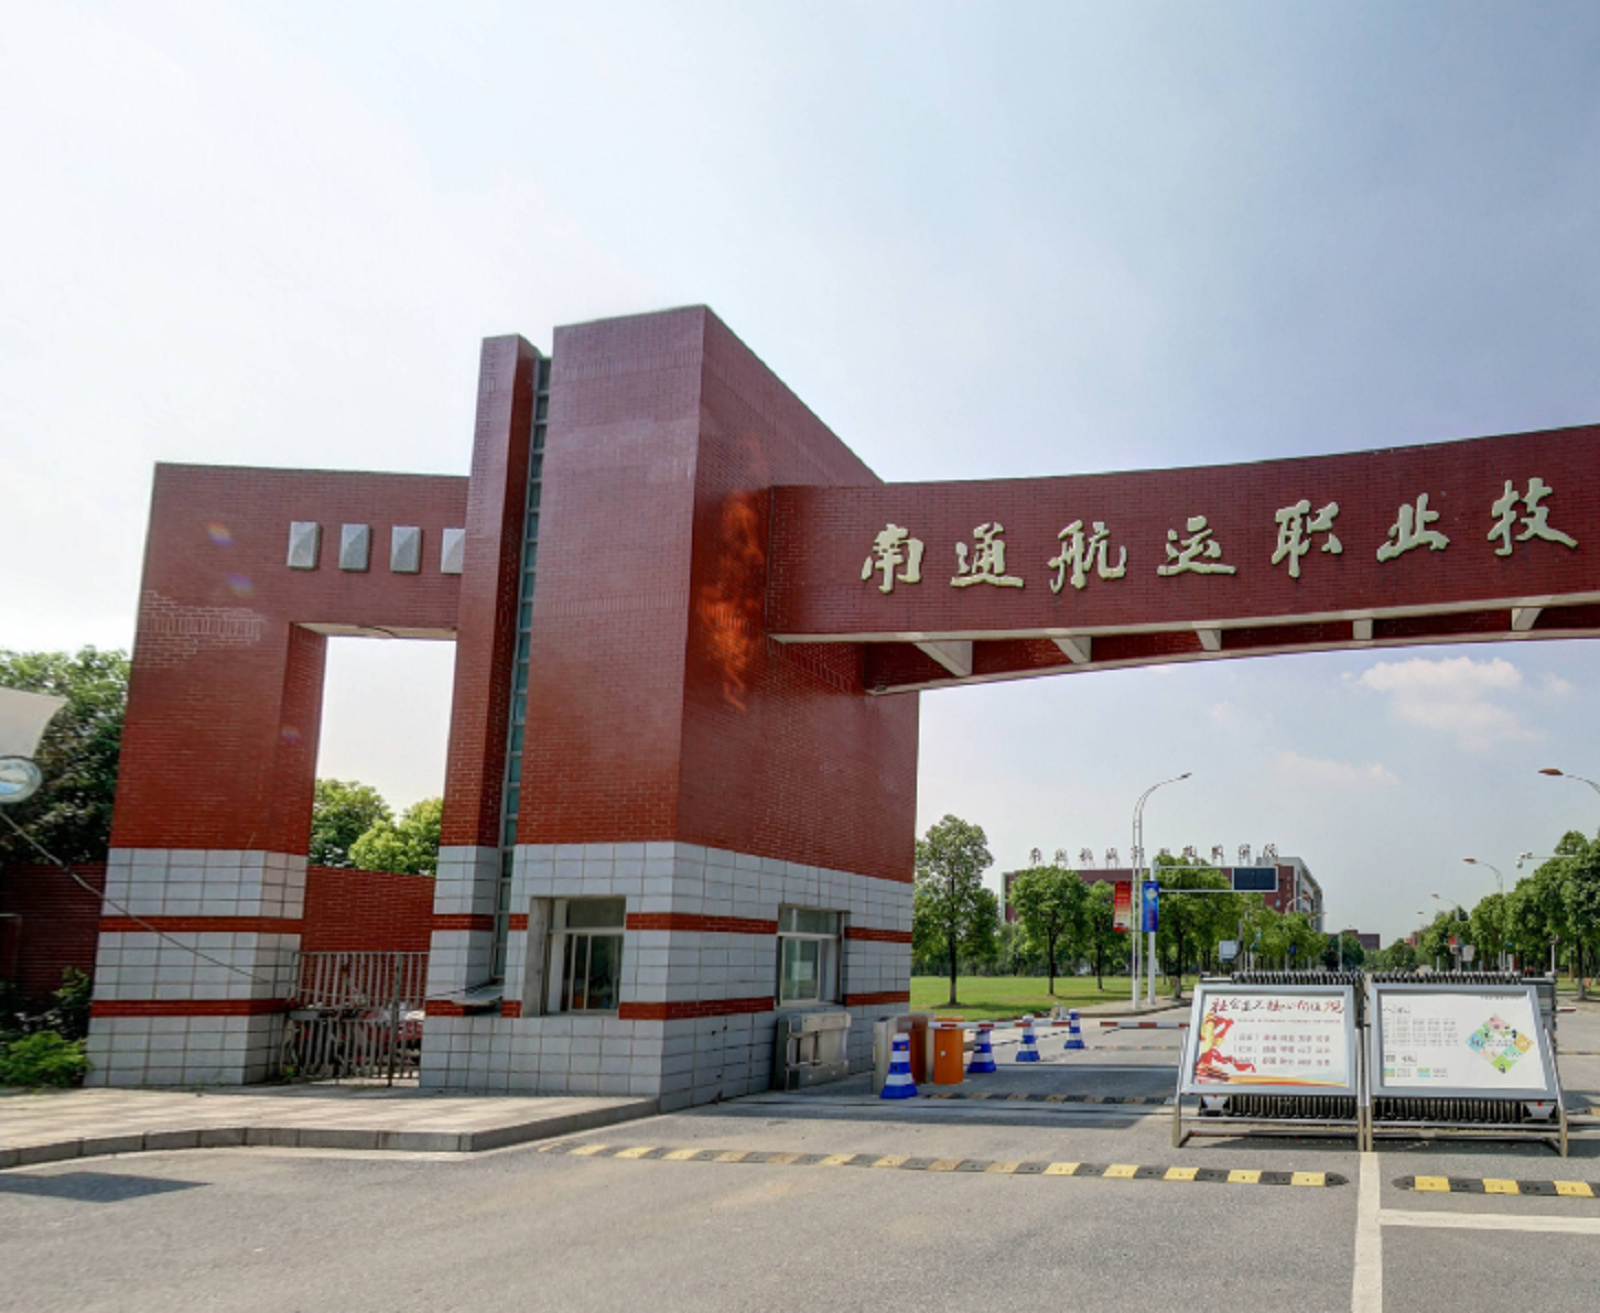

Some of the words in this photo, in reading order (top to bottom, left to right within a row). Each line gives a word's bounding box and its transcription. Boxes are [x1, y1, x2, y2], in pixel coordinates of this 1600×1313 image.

[861, 477, 1579, 594] 南通航运职业技
